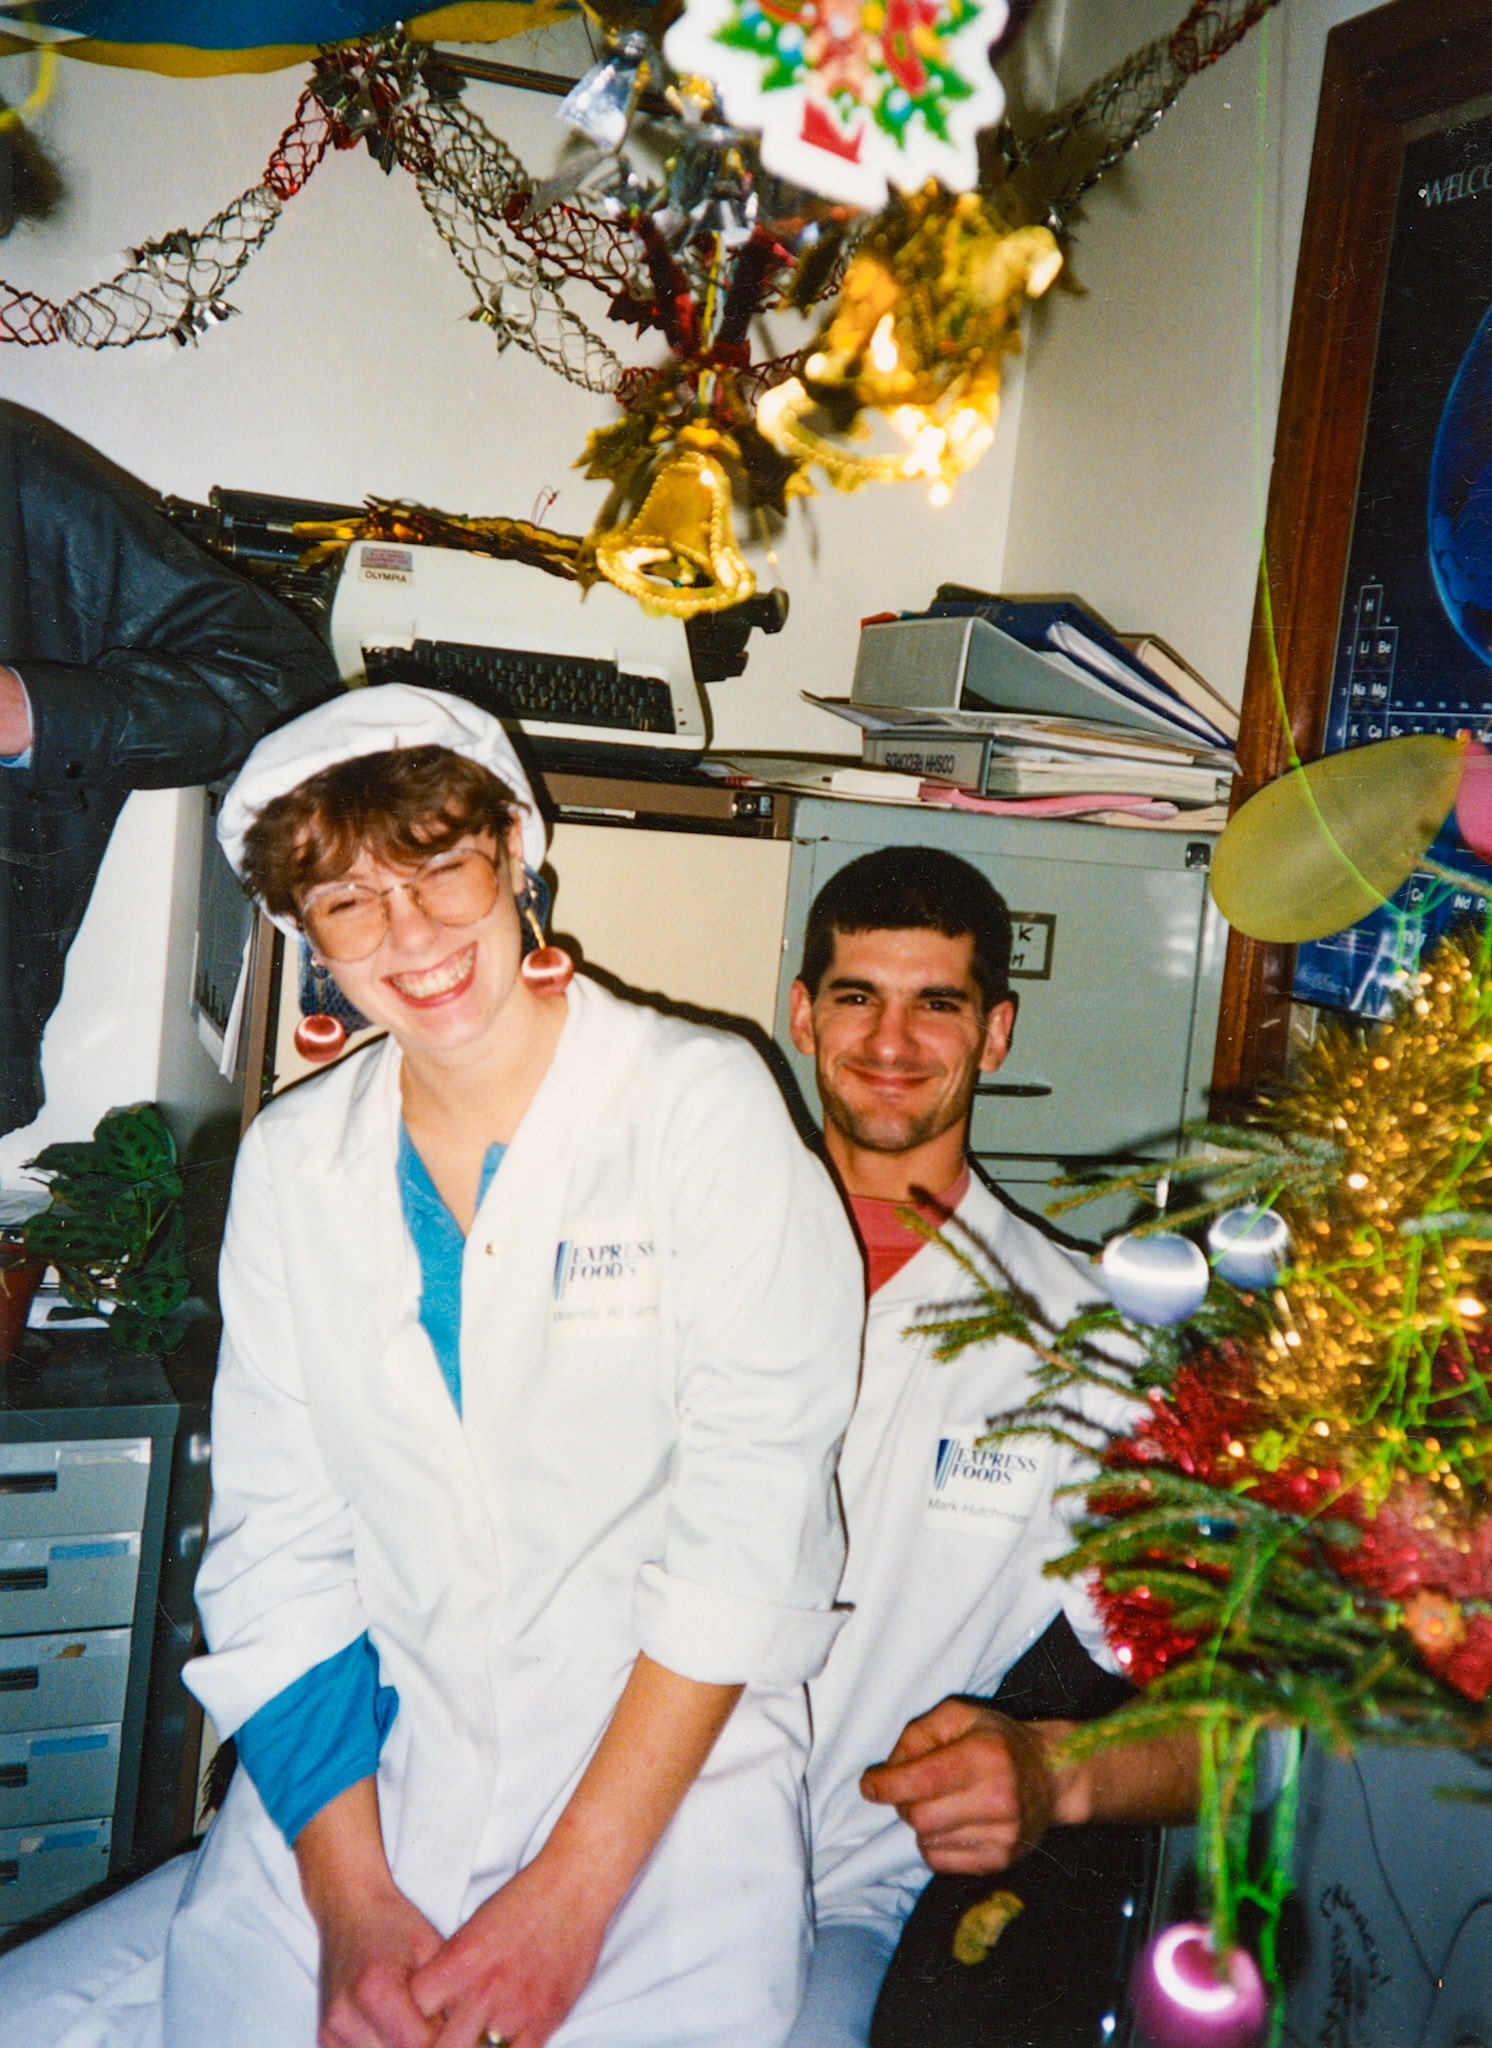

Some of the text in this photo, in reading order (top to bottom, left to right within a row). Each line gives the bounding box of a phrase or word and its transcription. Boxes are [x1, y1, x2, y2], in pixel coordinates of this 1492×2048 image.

[365, 570, 407, 582] OLYMPIA
[1365, 599, 1375, 612] H
[1378, 640, 1392, 654] Be
[1352, 682, 1366, 696] Na
[1371, 682, 1388, 699] Mg
[1350, 724, 1360, 737] K
[1368, 724, 1383, 738] Ca
[1454, 894, 1472, 910] Nd
[569, 1262, 636, 1282] FOOD
[957, 1447, 1037, 1474] EXPRESS
[951, 1462, 1012, 1486] FOODS
